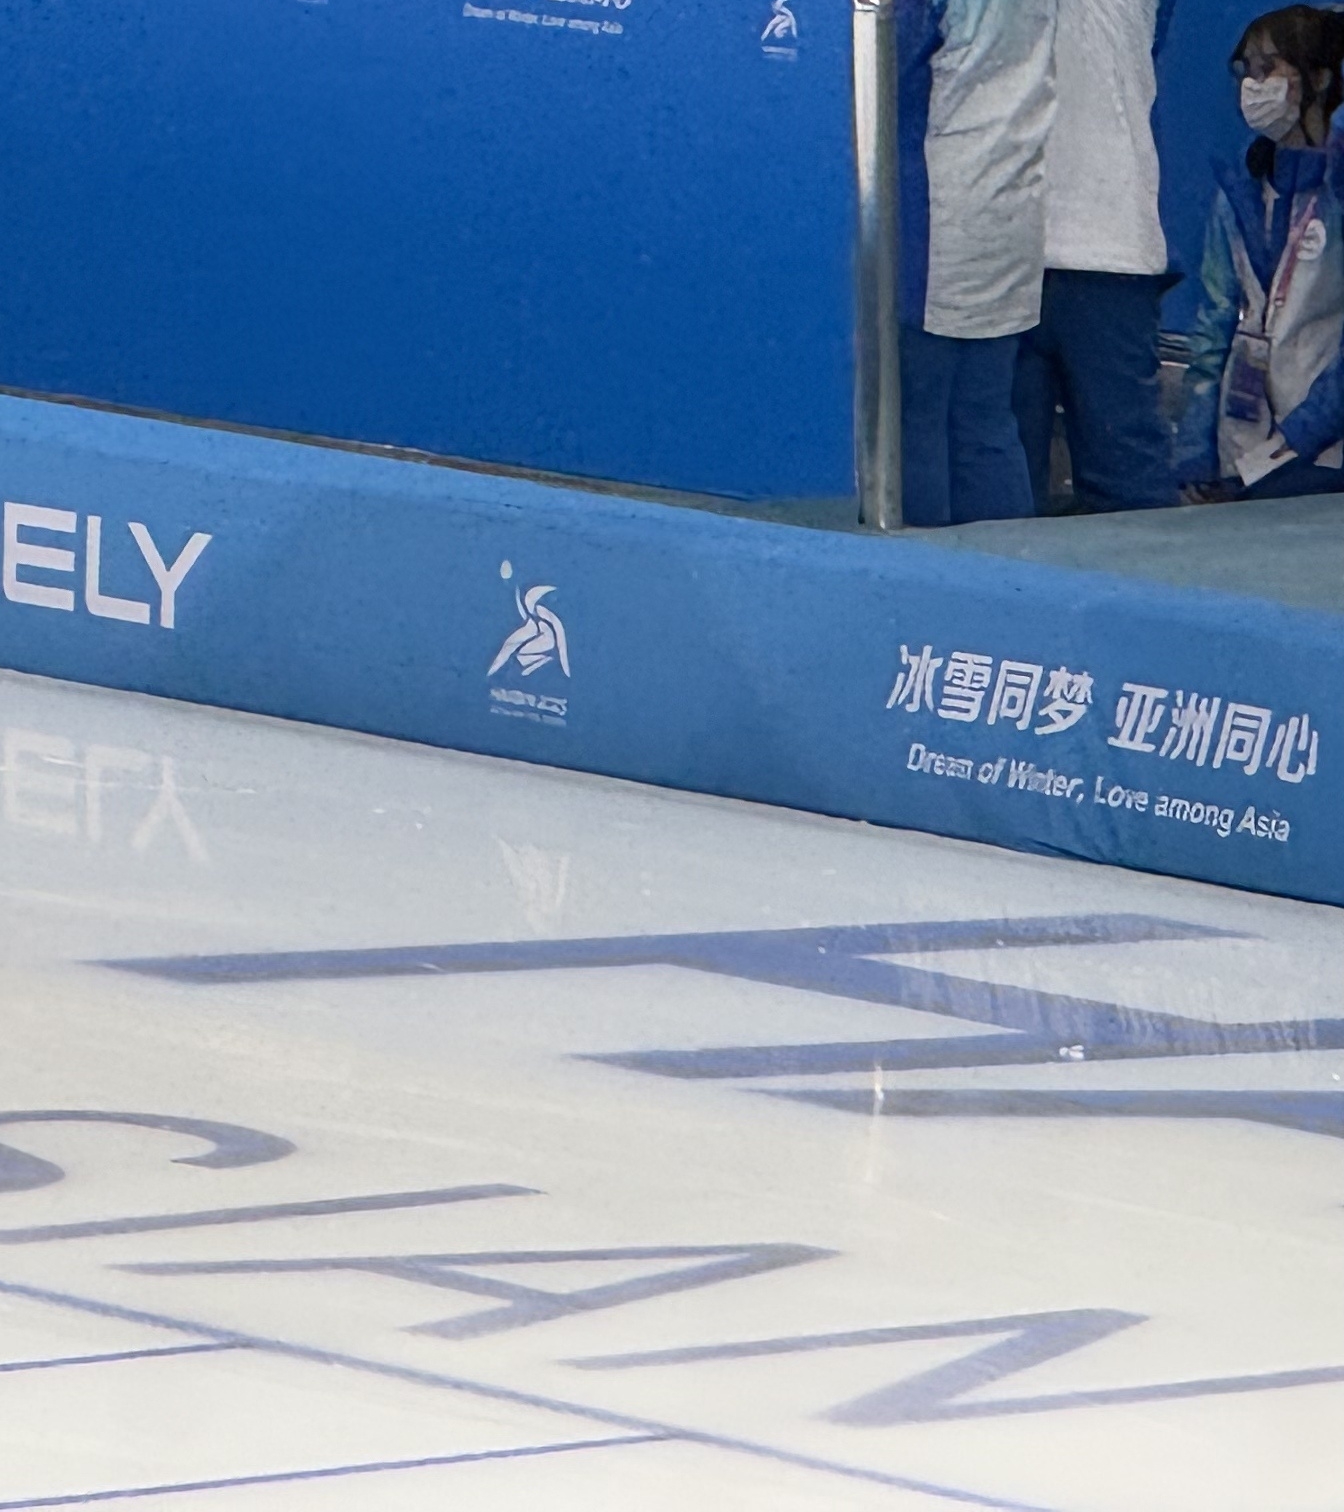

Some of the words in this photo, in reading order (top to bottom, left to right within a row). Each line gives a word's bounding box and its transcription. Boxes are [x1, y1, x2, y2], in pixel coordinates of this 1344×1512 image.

[885, 644, 1095, 736] 冰雪同梦
[1106, 682, 1319, 784] 亚洲同心
[905, 742, 974, 780] Dream
[977, 757, 1007, 786] of
[1094, 776, 1149, 812] Love
[1154, 795, 1235, 838] among
[1235, 805, 1291, 843] Asia
